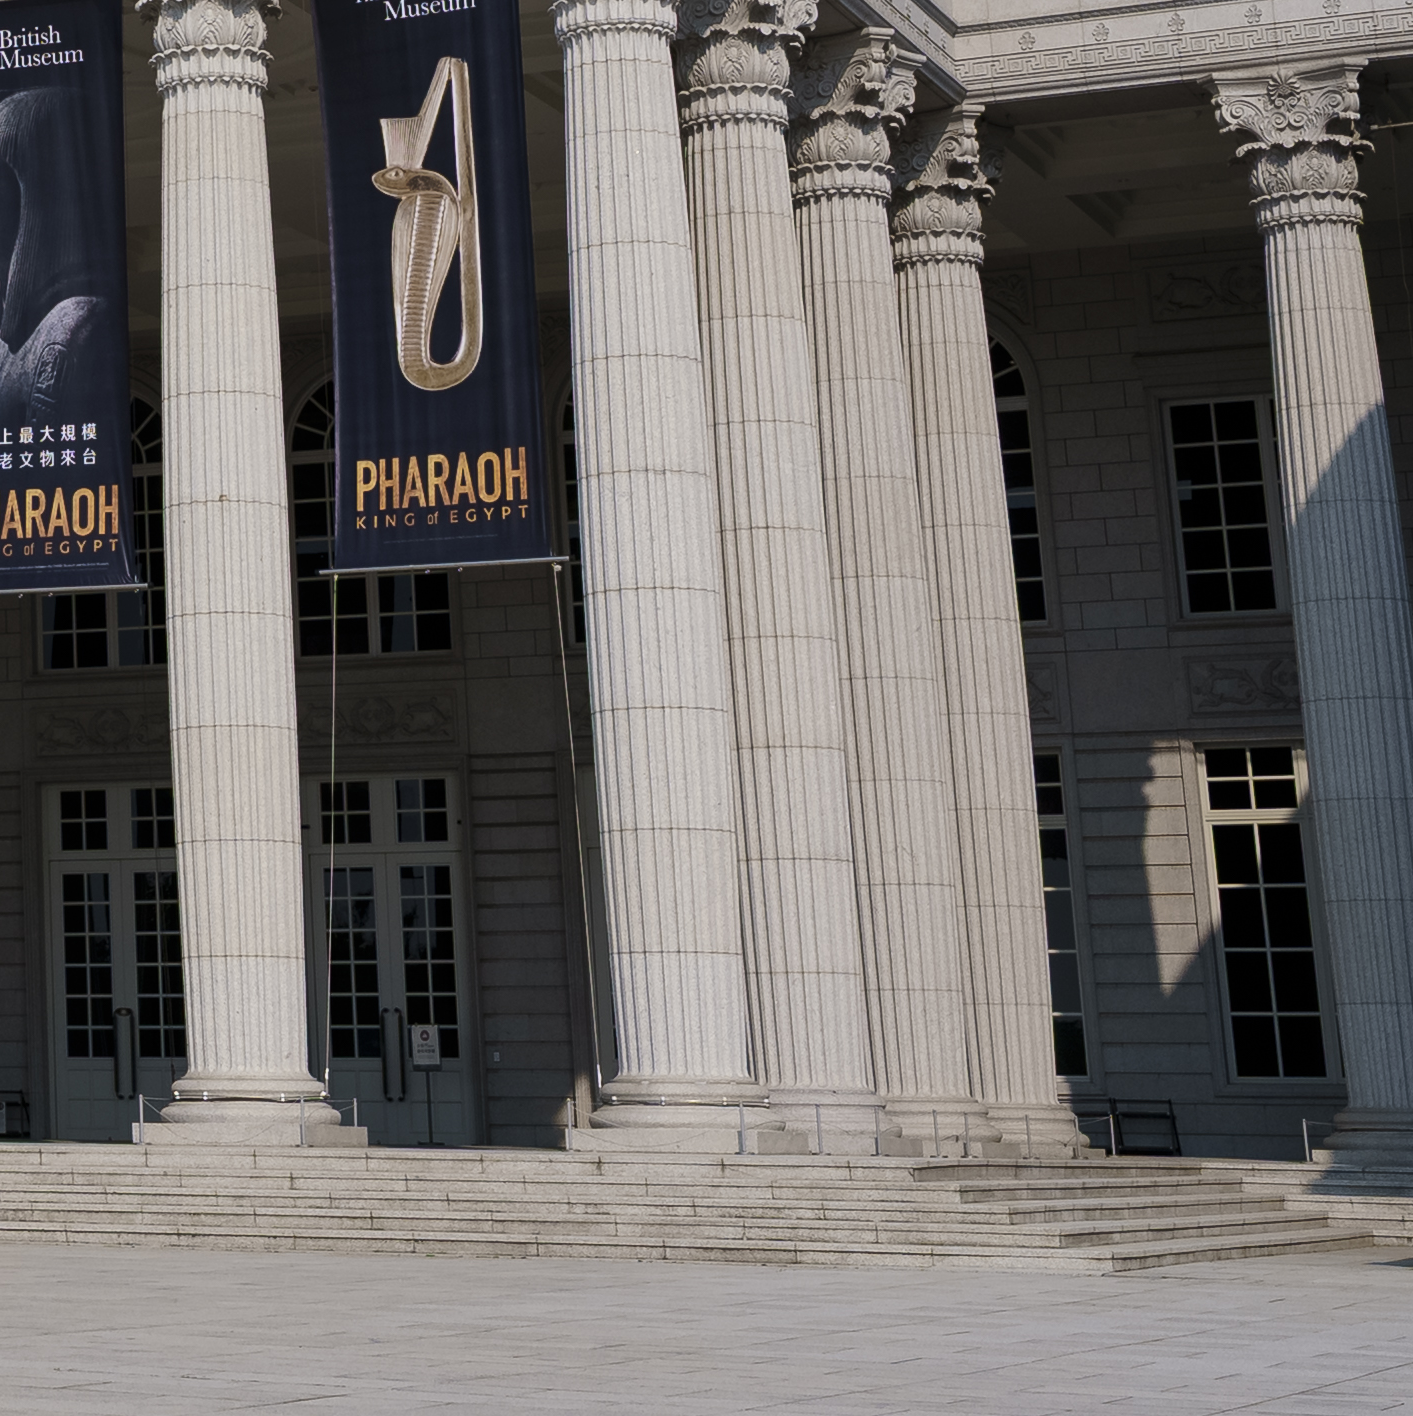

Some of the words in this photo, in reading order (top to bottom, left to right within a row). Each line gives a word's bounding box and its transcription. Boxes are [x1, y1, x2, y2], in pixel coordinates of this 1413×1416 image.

[356, 446, 528, 512] PHARAOH
[356, 512, 416, 530] KING
[427, 510, 439, 525] of
[449, 504, 529, 523] EGYPT
[23, 542, 35, 556] of
[44, 538, 118, 555] EGYPT
